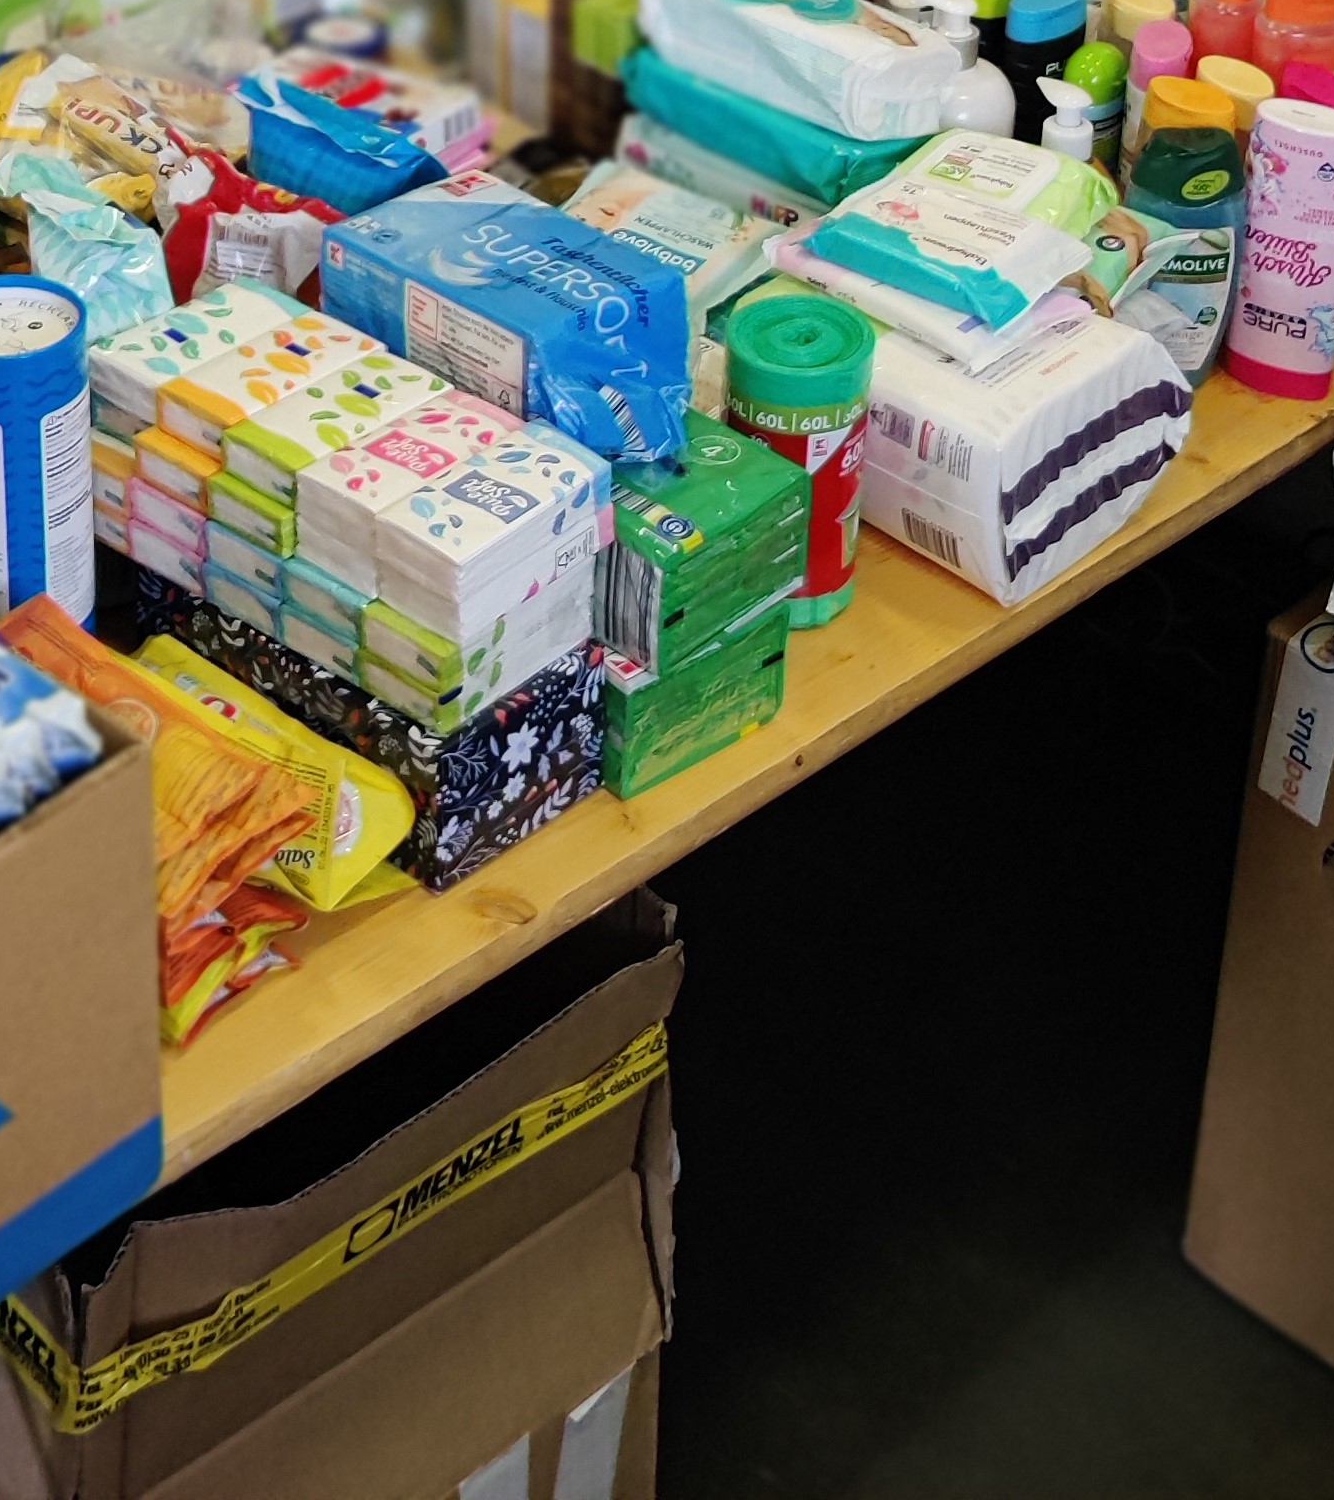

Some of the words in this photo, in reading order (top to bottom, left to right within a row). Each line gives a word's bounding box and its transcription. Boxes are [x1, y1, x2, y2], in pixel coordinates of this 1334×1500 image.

[1044, 58, 1066, 77] PU
[610, 228, 699, 274] babylove
[1241, 311, 1308, 341] PURE
[755, 412, 789, 431] 60L
[799, 414, 833, 432] 60L
[396, 1113, 527, 1218] MENZEL
